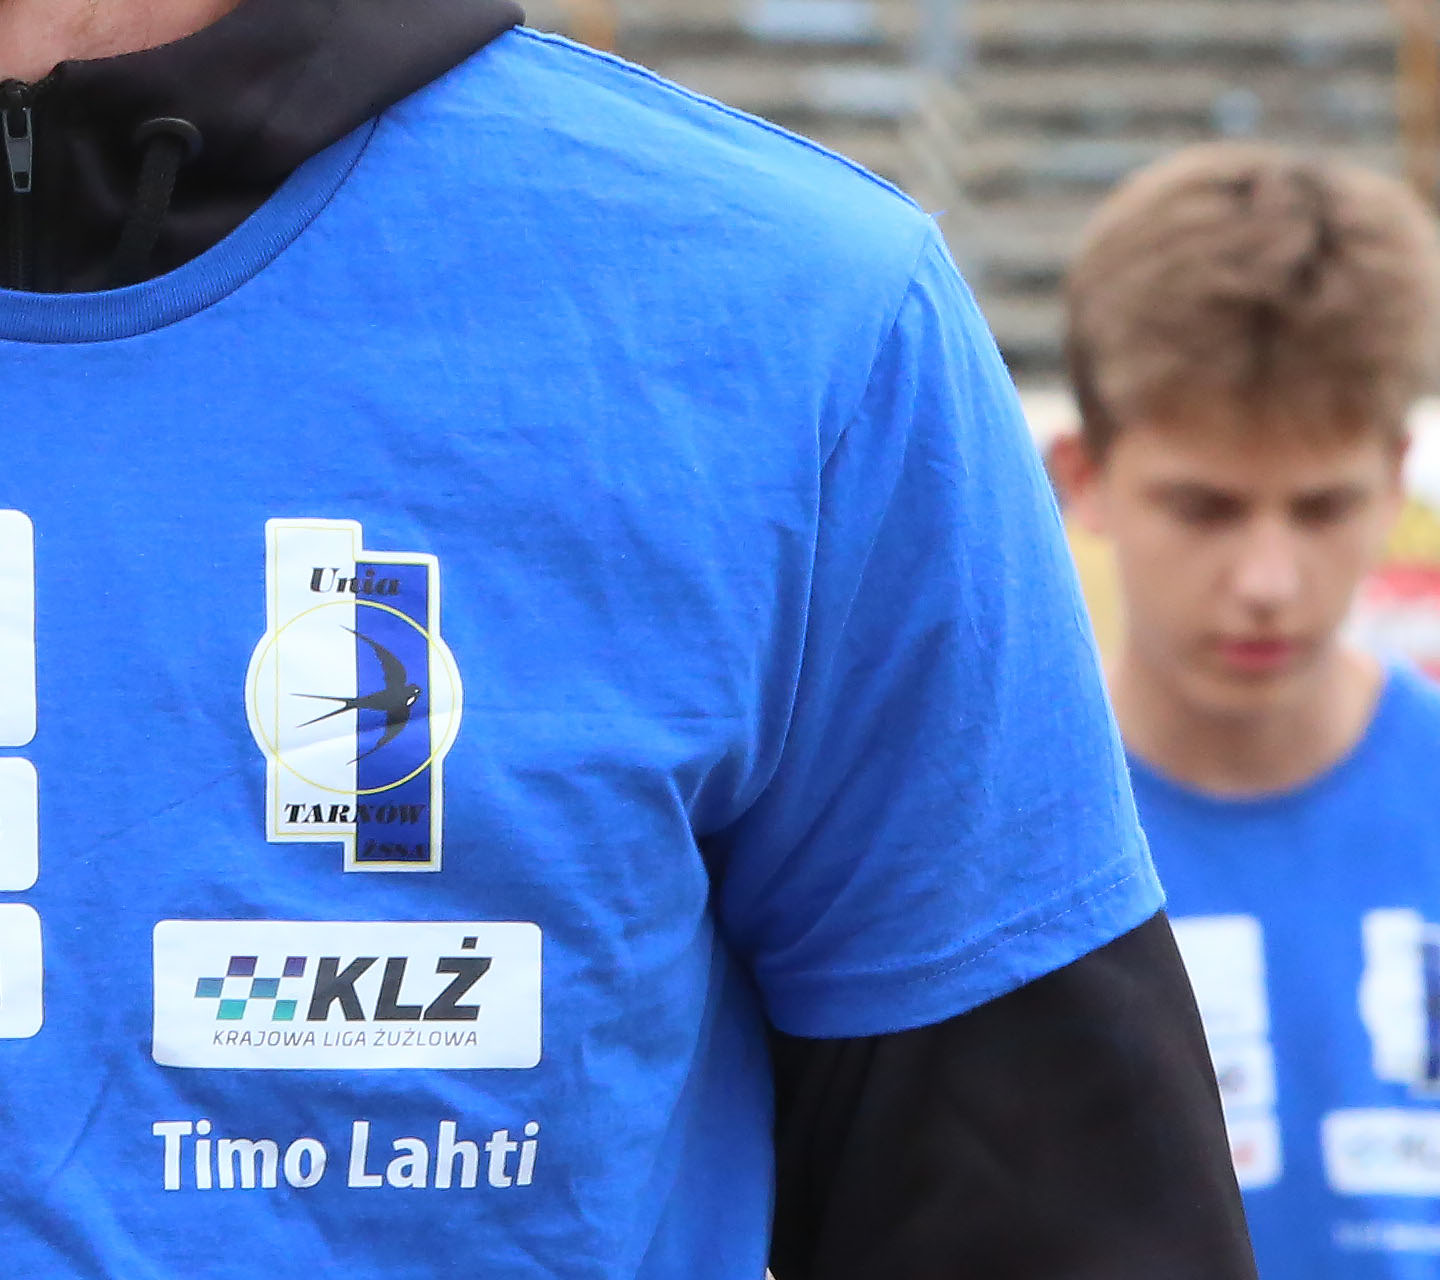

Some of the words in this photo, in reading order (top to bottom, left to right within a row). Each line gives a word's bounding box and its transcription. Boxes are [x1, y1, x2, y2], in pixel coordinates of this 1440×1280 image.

[309, 567, 400, 596] Unia
[305, 936, 493, 1022] KLŻ
[212, 1030, 316, 1047] KRAJOWA
[323, 1030, 367, 1047] LIGA
[373, 1027, 478, 1047] ŻUŻLOWA
[152, 1119, 329, 1191] Timo
[347, 1119, 540, 1190] Lahti
